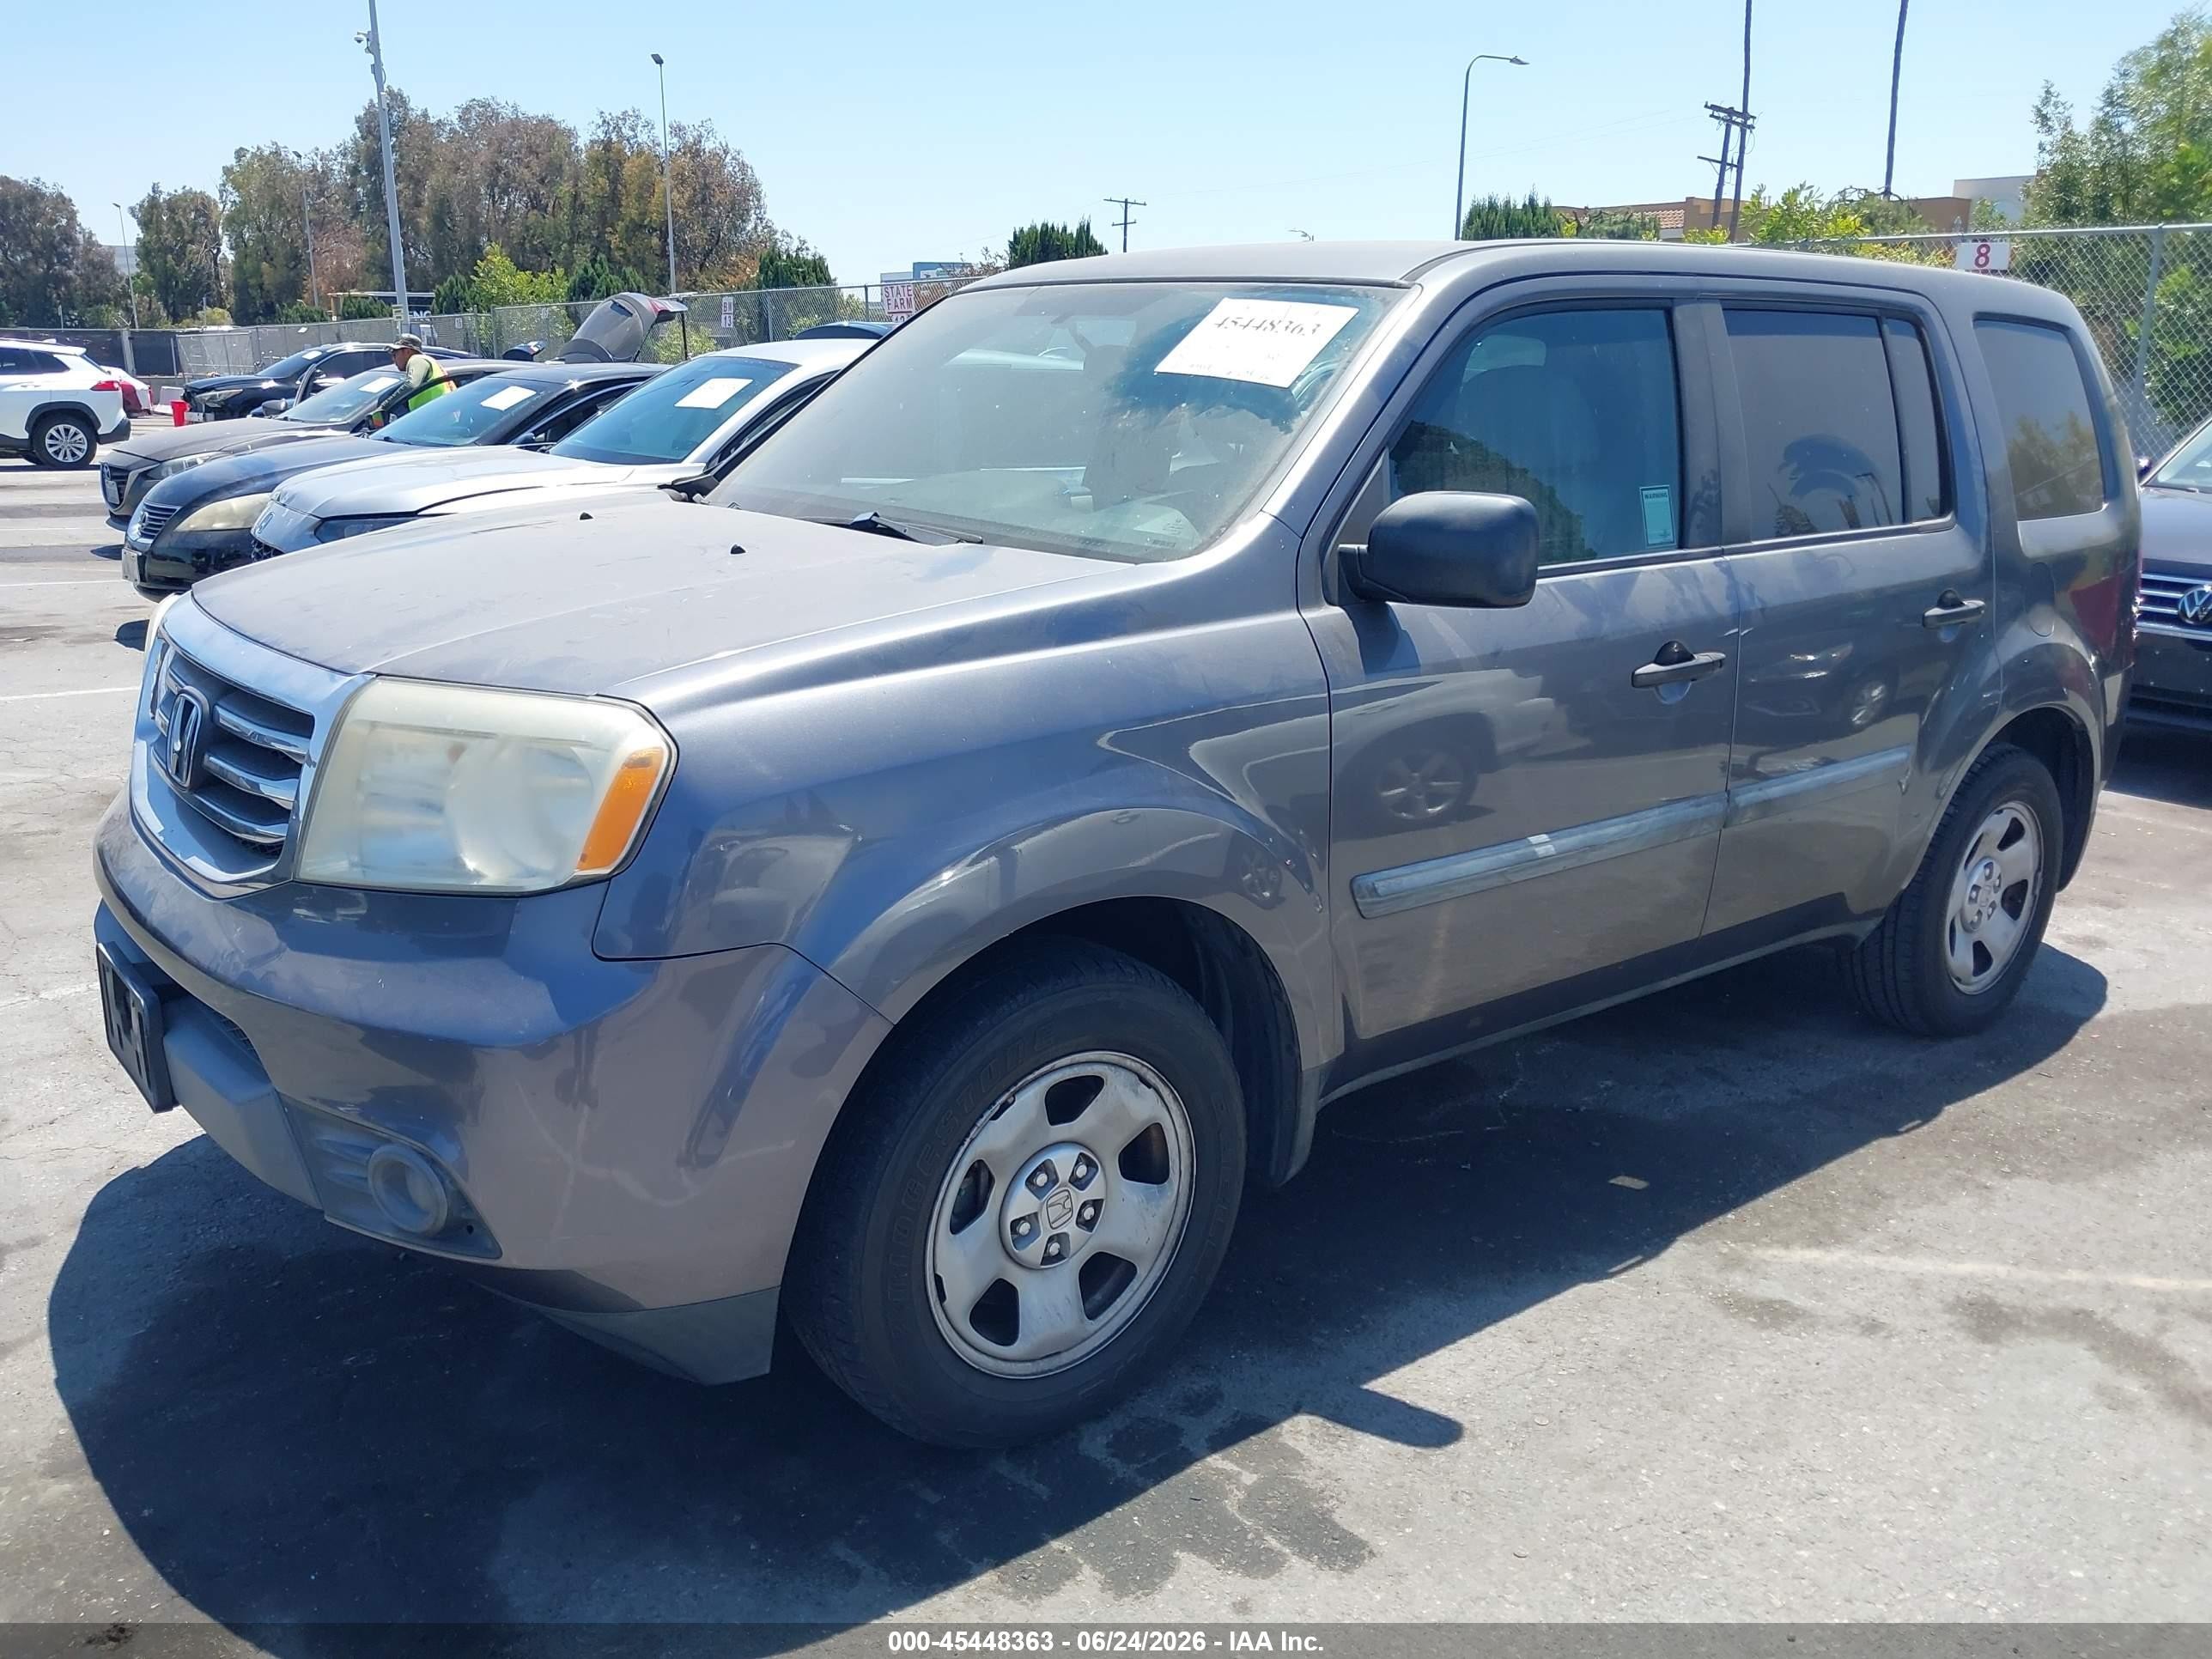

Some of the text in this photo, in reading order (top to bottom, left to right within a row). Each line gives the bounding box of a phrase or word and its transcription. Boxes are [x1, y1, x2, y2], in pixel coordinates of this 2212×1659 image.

[1975, 244, 1990, 268] 8
[884, 286, 913, 298] STATE
[887, 298, 913, 310] FARM
[1213, 316, 1322, 337] 45448363
